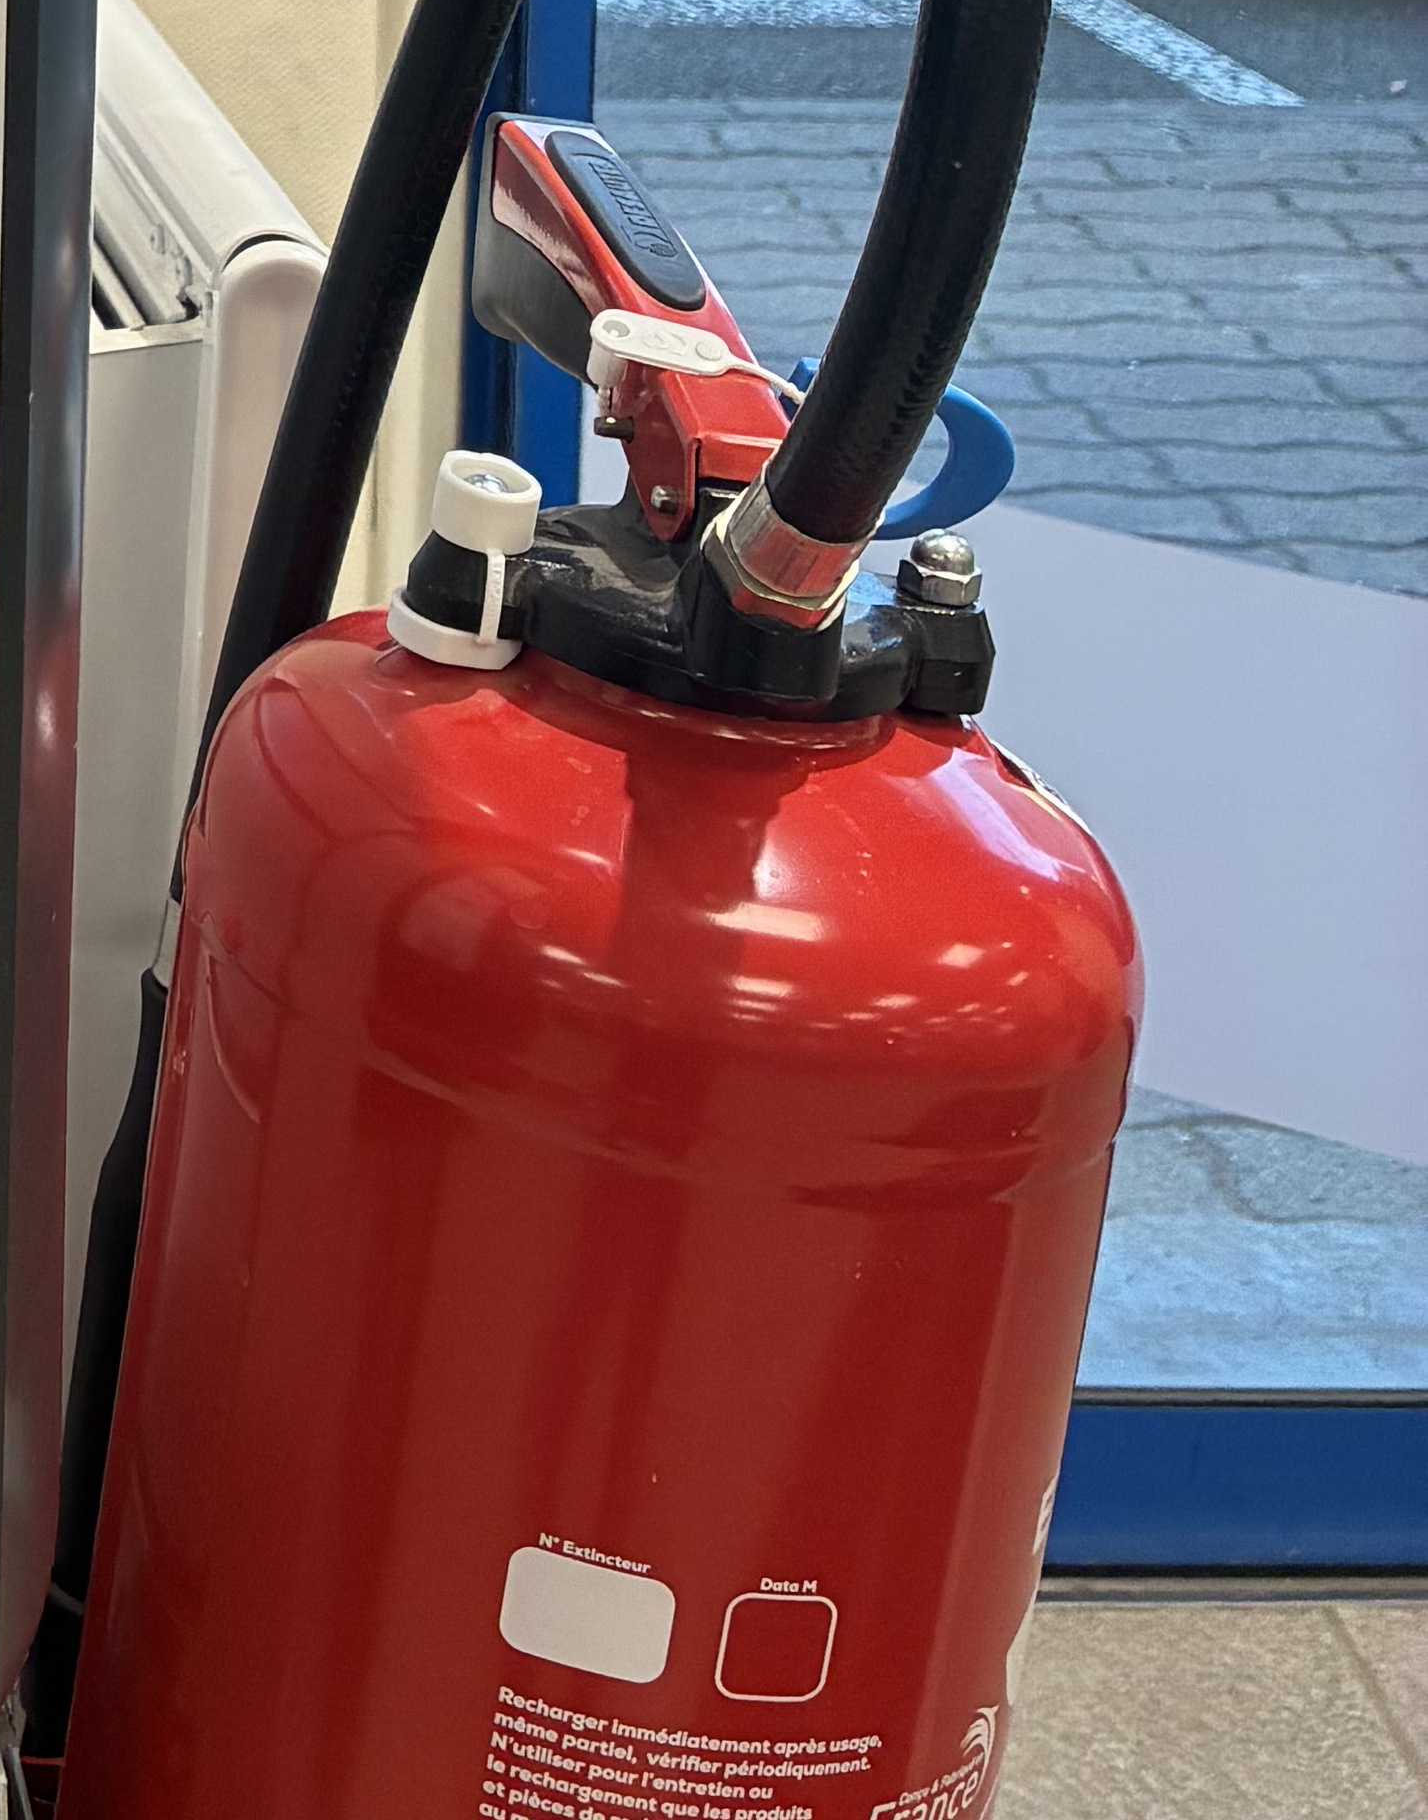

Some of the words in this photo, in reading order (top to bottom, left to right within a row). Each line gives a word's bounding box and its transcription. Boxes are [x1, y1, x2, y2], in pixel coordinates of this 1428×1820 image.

[539, 1532, 560, 1548] N°
[562, 1540, 652, 1574] Extincteur
[802, 1579, 818, 1593] M
[498, 1685, 609, 1732] Recharger
[612, 1718, 771, 1754] immédiatement
[773, 1737, 826, 1758] après
[829, 1734, 882, 1754] usage,
[493, 1711, 559, 1743] même
[561, 1733, 638, 1765] partiel,
[646, 1747, 722, 1774] vérifier
[723, 1756, 871, 1780] périodiquement.
[482, 1779, 506, 1798] et
[508, 1788, 575, 1818] pièces
[486, 1753, 506, 1774] le
[509, 1763, 658, 1812] rechargement
[660, 1800, 700, 1819] que
[703, 1802, 731, 1820] les
[735, 1805, 812, 1820] produits
[588, 1764, 639, 1787] pour
[640, 1771, 746, 1798] l'entretien
[748, 1785, 773, 1799] ou
[478, 1801, 506, 1820] au
